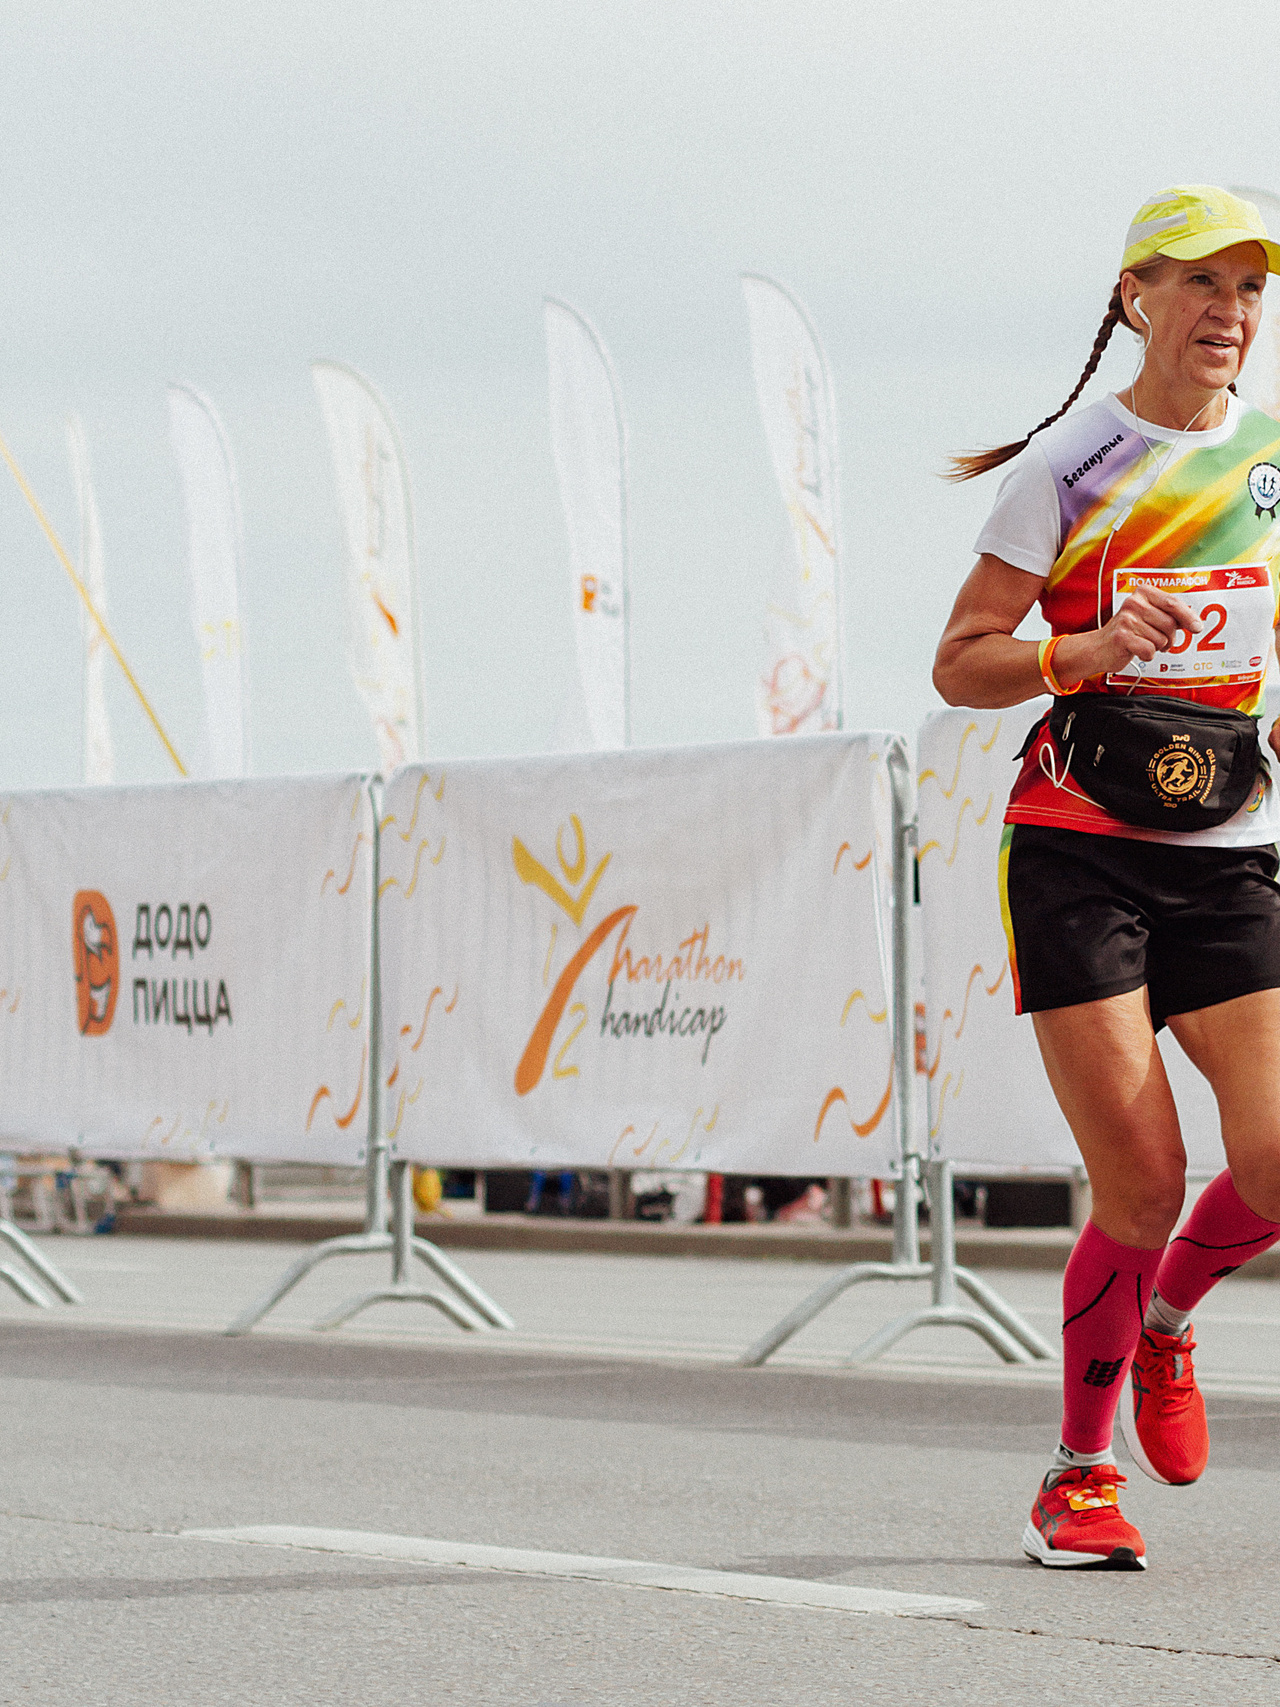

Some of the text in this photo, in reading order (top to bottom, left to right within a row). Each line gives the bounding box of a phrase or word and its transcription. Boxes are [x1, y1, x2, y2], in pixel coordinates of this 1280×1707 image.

[1129, 576, 1208, 587] ПОЛУМАРАФОН
[1153, 743, 1204, 764] GOLDEN RING
[1151, 783, 1201, 802] ULTRA TRAIL
[131, 902, 212, 961] ДОДО
[132, 978, 234, 1037] ПИЦЦА
[600, 978, 727, 1067] handicap
